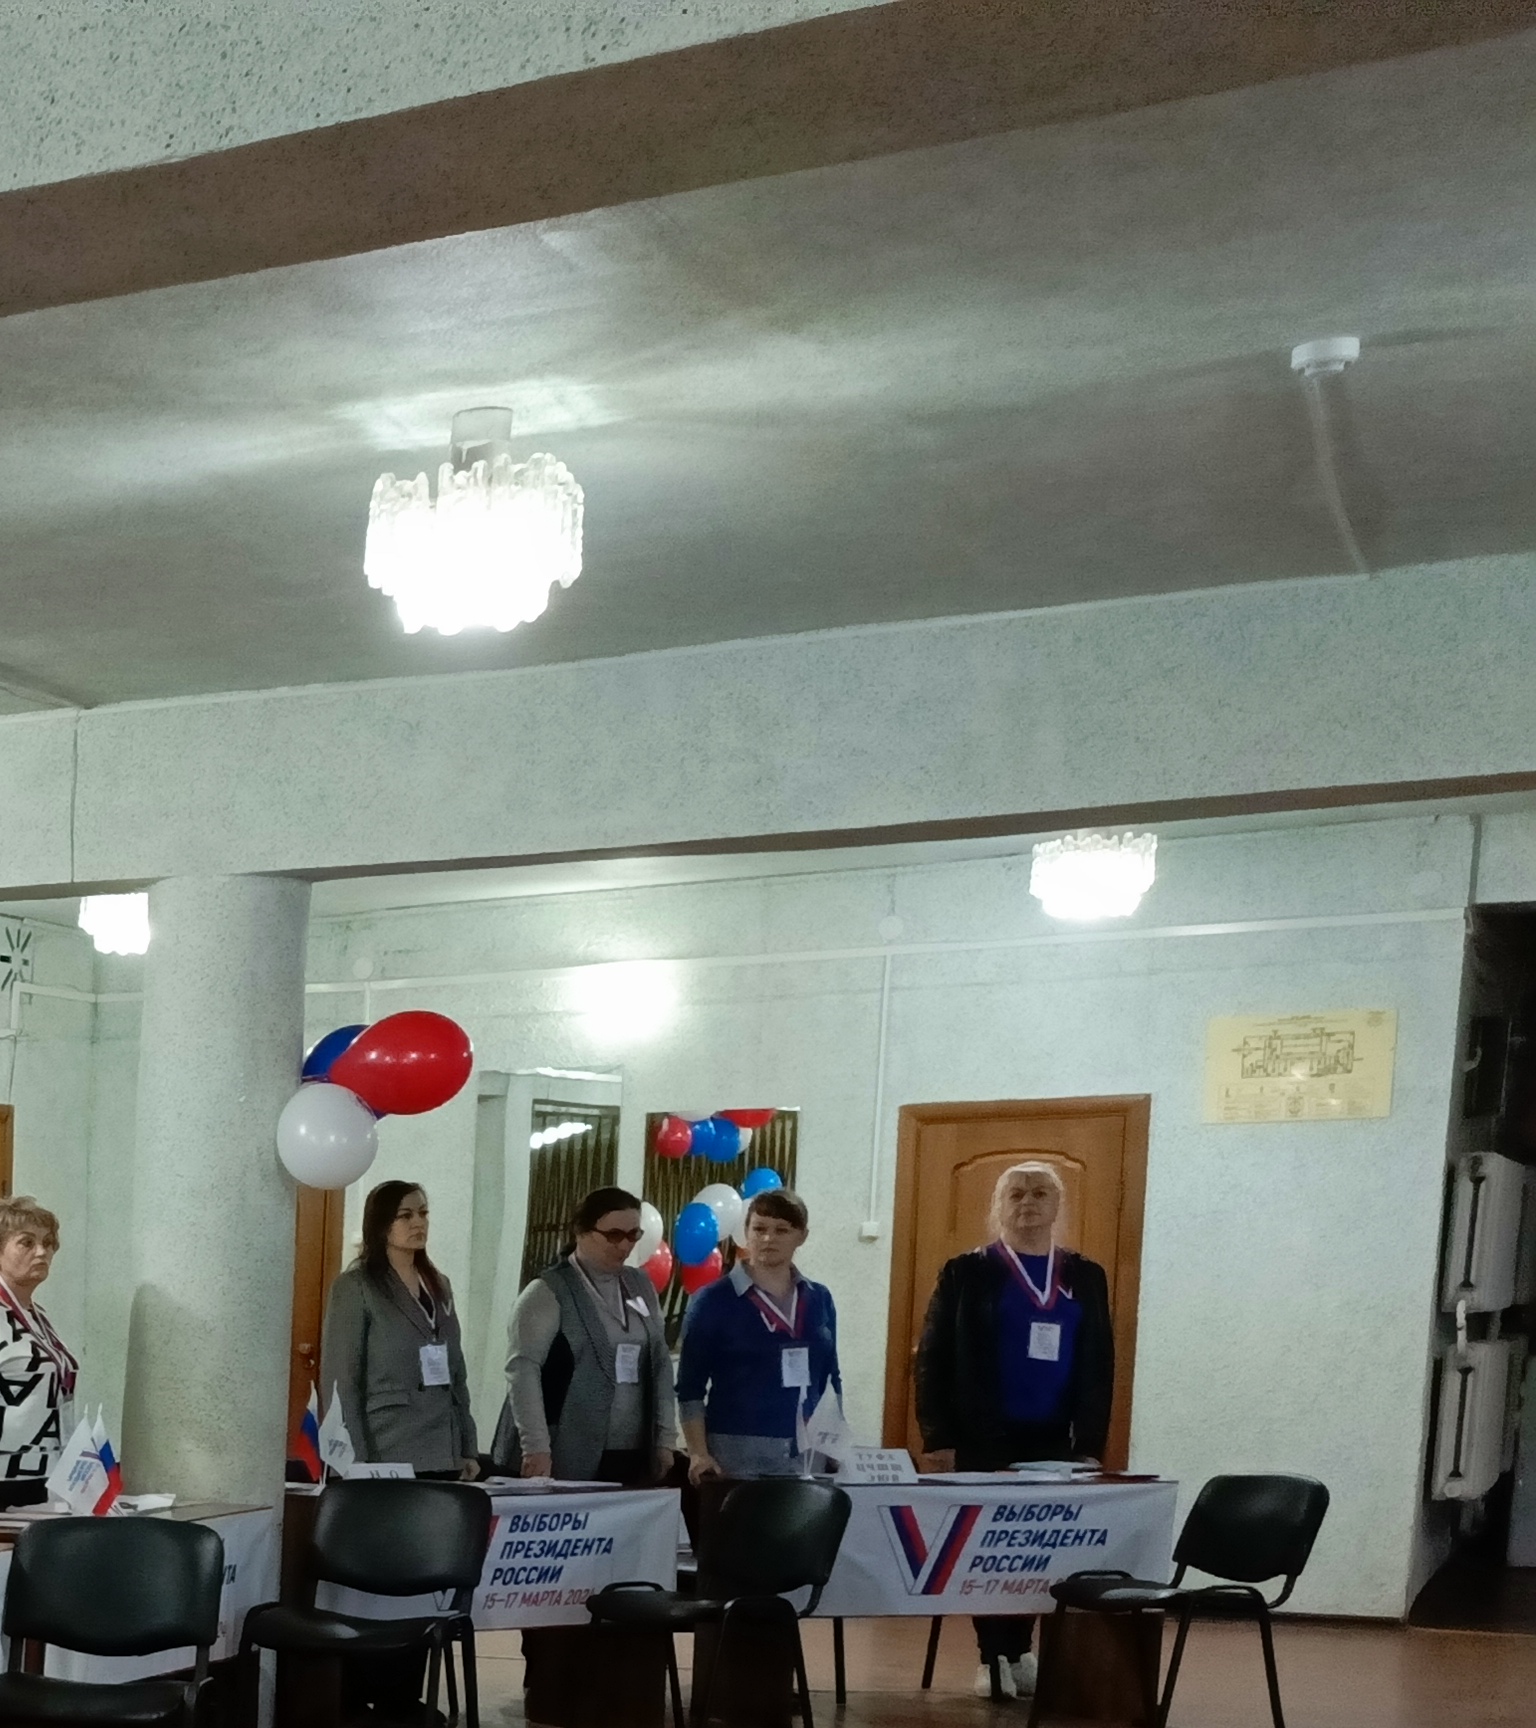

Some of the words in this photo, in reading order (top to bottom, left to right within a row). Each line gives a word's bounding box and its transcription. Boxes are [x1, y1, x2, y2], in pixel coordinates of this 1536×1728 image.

[508, 1512, 589, 1534] ВЫБОРЫ
[992, 1504, 1083, 1523] ВЫБОРЫ
[499, 1537, 614, 1560] ПРЕЗИДЕНТА
[979, 1528, 1109, 1550] ПРЕЗИДЕНТА
[968, 1554, 1052, 1574] РОССИИ
[489, 1565, 564, 1586] РОССИИ
[1000, 1578, 1051, 1595] МАРТА
[518, 1590, 563, 1608] МАРТА
